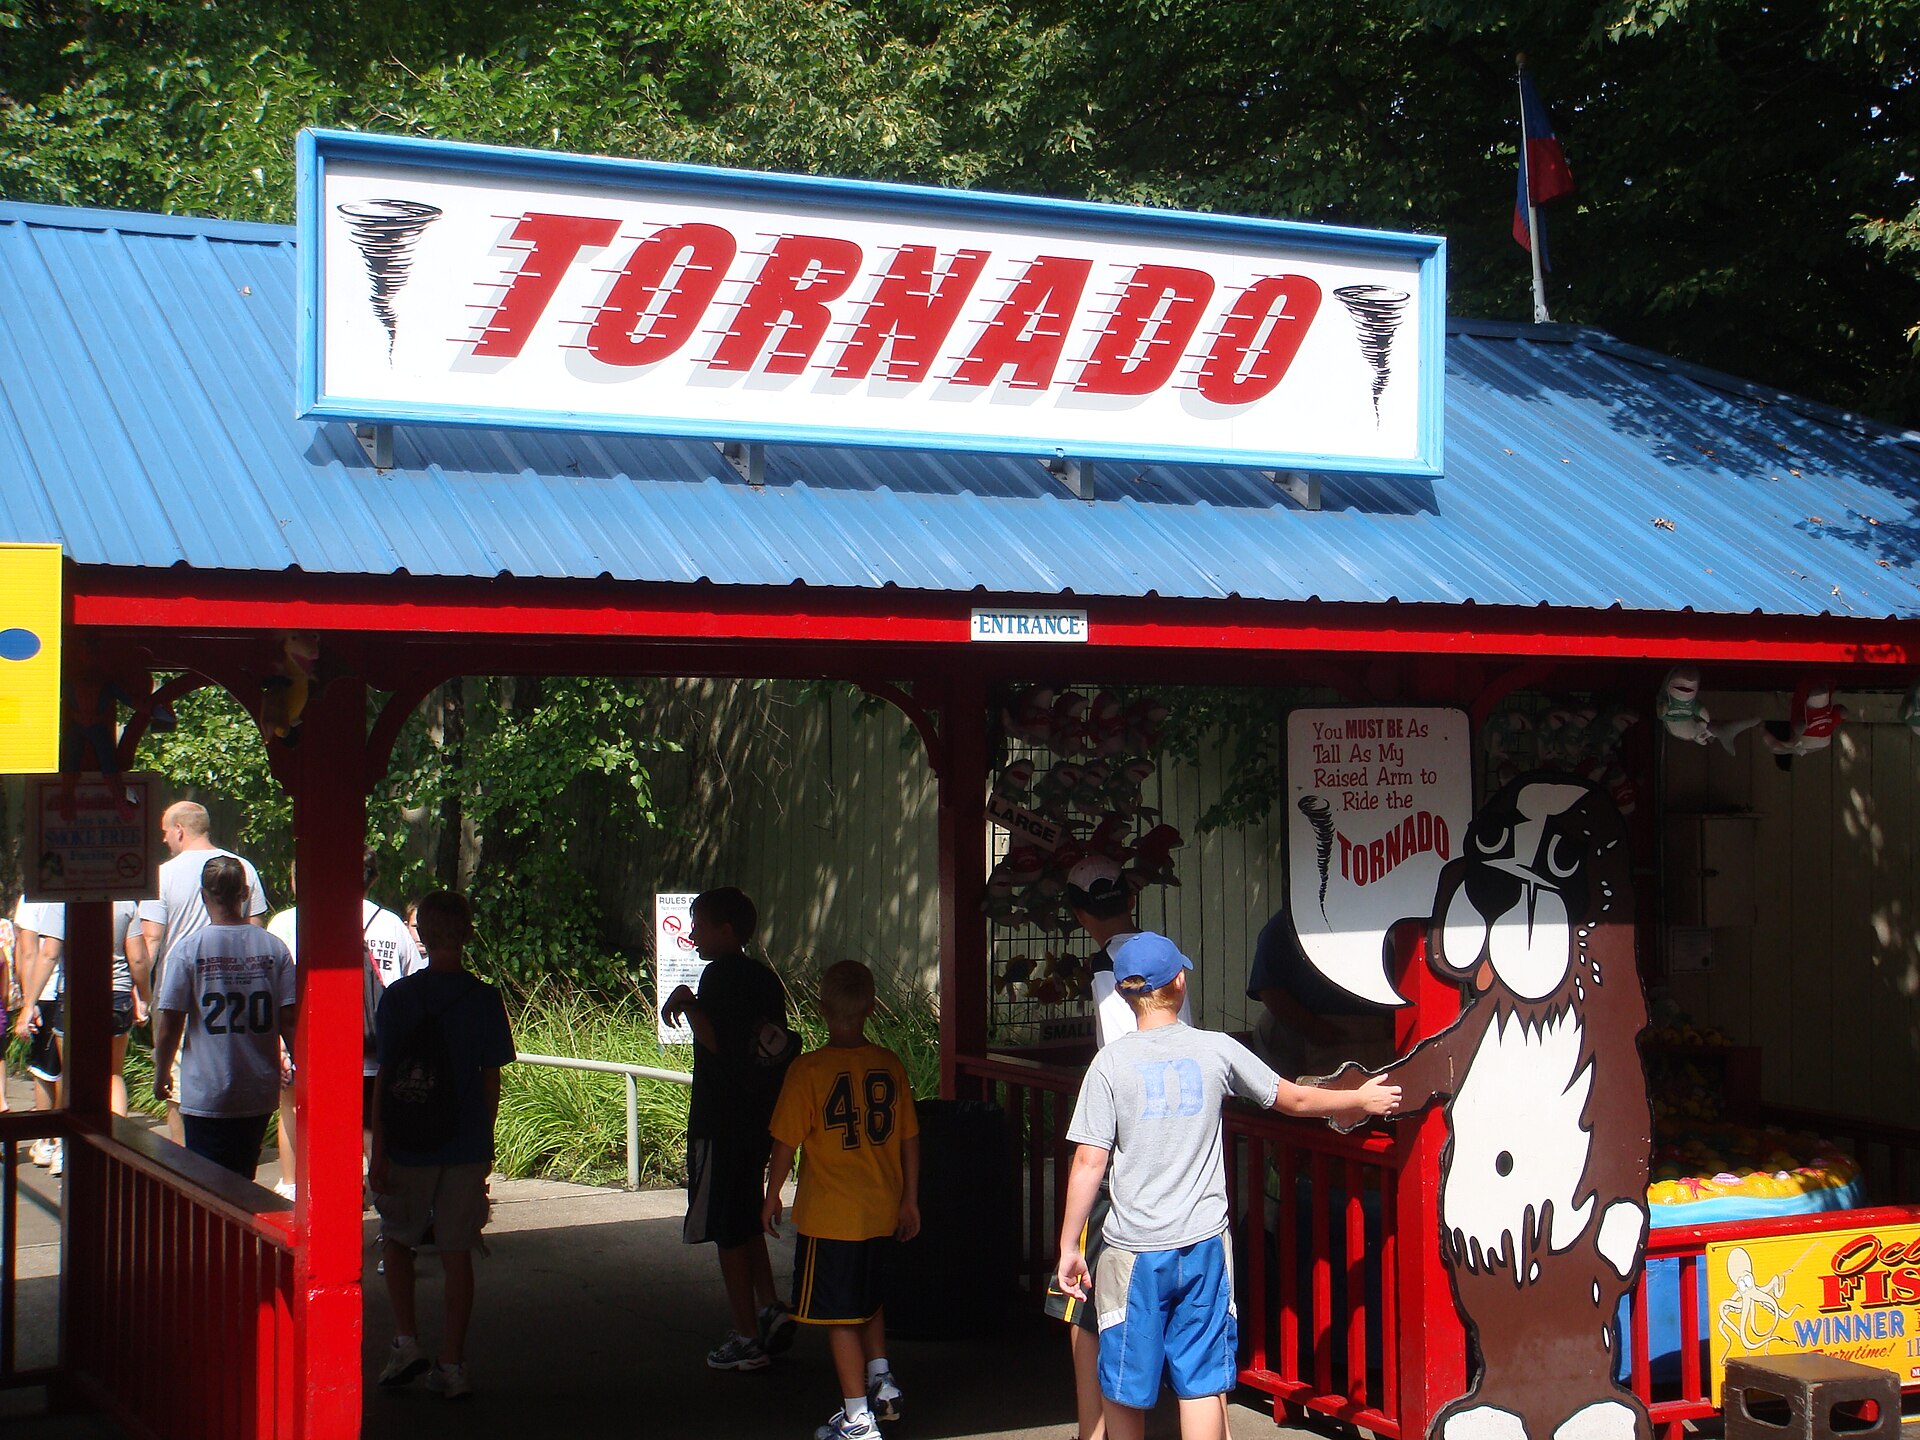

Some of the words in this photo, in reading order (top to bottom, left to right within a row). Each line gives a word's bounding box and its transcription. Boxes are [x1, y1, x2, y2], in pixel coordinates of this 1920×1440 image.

[448, 211, 1323, 406] TORNADO
[978, 614, 1080, 635] ENTRANCE
[1312, 722, 1342, 740] You
[1345, 719, 1384, 739] MUST
[1387, 719, 1403, 738] BE
[1406, 718, 1429, 737] As
[1313, 744, 1341, 764] Tall
[1348, 743, 1371, 762] As
[1378, 743, 1404, 767] My
[1314, 767, 1368, 788] Raised
[1376, 766, 1413, 786] Arm
[1420, 768, 1437, 784] to
[1342, 791, 1379, 811] Ride
[1386, 791, 1413, 809] the
[989, 800, 1057, 845] LARGE
[1336, 810, 1450, 887] TORNADO
[659, 896, 687, 905] RULES
[379, 940, 397, 950] YOU
[202, 990, 273, 1035] 220
[1043, 1020, 1095, 1040] SMALL
[823, 1069, 897, 1149] 48
[1794, 1310, 1905, 1347] WINNER
